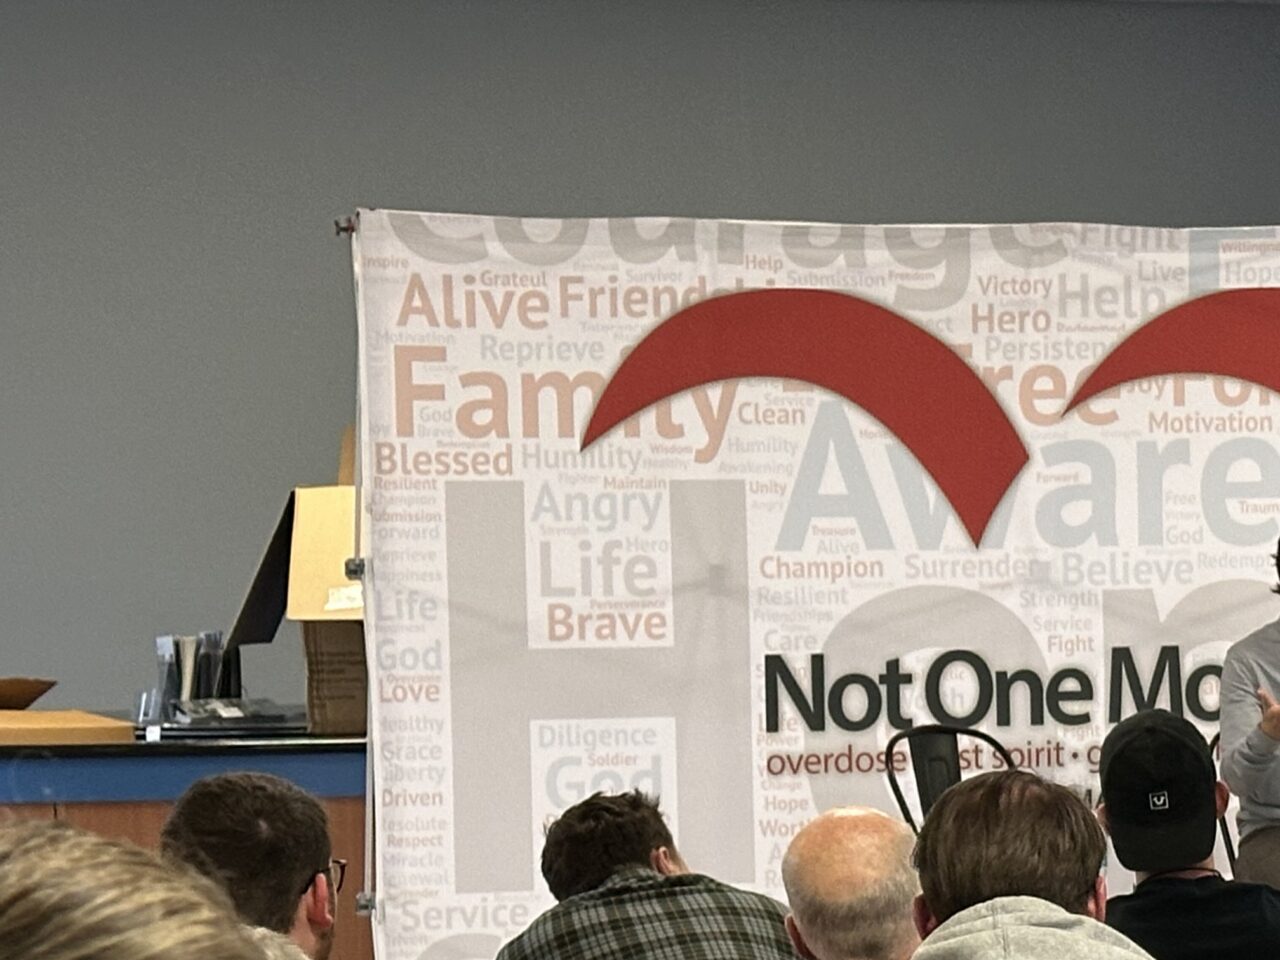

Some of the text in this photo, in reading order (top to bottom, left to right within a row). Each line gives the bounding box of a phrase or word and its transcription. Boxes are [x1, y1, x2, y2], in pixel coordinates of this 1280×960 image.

[745, 254, 784, 273] Help
[1137, 260, 1186, 282] Live
[786, 270, 887, 288] Submission
[978, 275, 1052, 298] Victory
[396, 272, 550, 330] Alive
[1057, 272, 1167, 319] Help
[972, 302, 1051, 334] Hero
[480, 334, 605, 367] Reprieve
[419, 406, 453, 422] God
[737, 401, 806, 426] Clean
[1147, 411, 1274, 434] Motivation
[521, 443, 643, 472] Humility
[727, 437, 799, 456] Humility
[374, 441, 514, 476] Blessed
[373, 476, 438, 491] Resilient
[603, 475, 667, 490] Maintain
[1036, 470, 1081, 483] Forward
[749, 481, 787, 496] Unity
[1165, 490, 1197, 505] Free
[531, 480, 663, 532] Angry
[624, 535, 668, 552] Hero
[1165, 525, 1205, 545] God
[815, 539, 861, 556] Alive
[538, 539, 658, 597] Life
[759, 555, 884, 583] Champion
[1061, 551, 1195, 587] Believe
[376, 589, 439, 622] Life
[757, 586, 850, 605] Resilient
[1019, 589, 1099, 610] Strength
[547, 602, 668, 642] Brave
[1032, 613, 1094, 633] Service
[763, 628, 819, 651] Care
[1047, 634, 1096, 657] Fight
[376, 637, 443, 672] God
[378, 677, 441, 704] Love
[763, 643, 1224, 734] Not One Mo
[536, 723, 658, 752] Diligence
[587, 751, 638, 767] Soldier
[765, 742, 909, 777] overdose
[382, 787, 444, 808] Driven
[764, 795, 810, 815] Hope
[401, 898, 531, 932] Service
